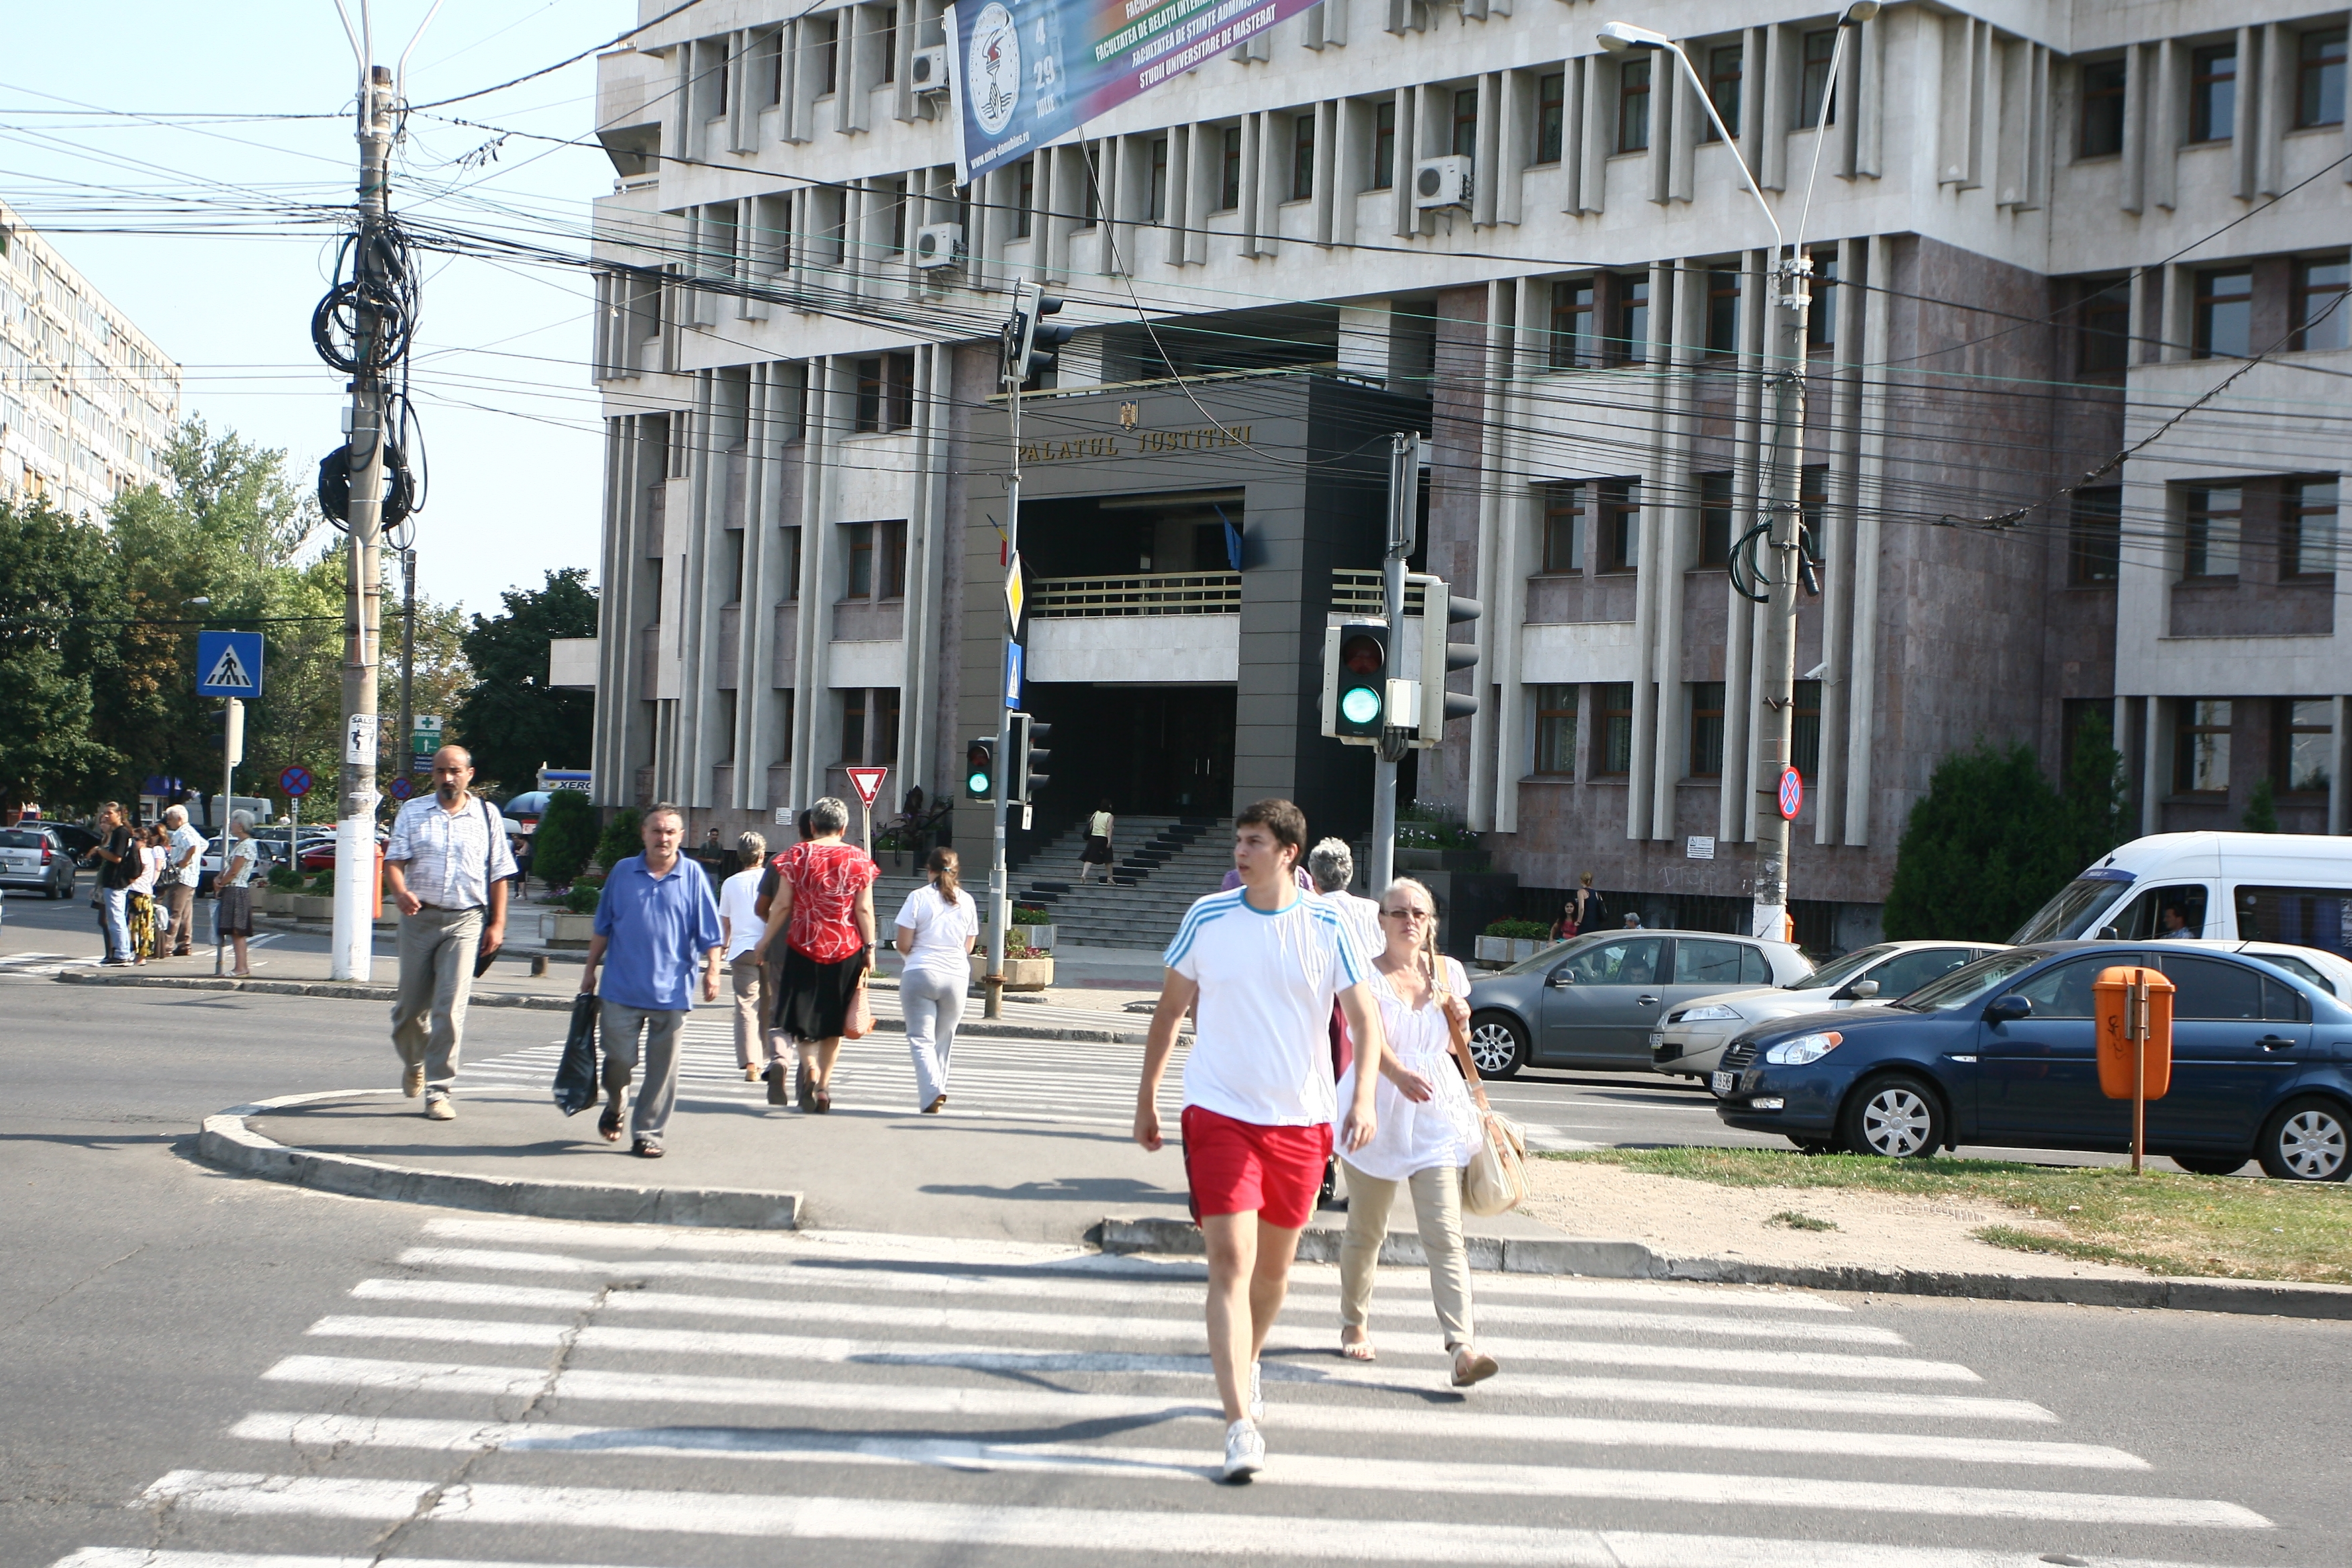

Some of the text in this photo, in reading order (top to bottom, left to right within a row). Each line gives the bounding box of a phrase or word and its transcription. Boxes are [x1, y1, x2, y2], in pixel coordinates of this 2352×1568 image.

[1125, 0, 1163, 19] FACUL
[1036, 17, 1046, 45] 4
[1095, 26, 1138, 62] FACULTATEA
[1138, 19, 1148, 39] DE
[1132, 32, 1175, 68] FACULTATEA
[1175, 26, 1186, 45] DE
[1139, 3, 1277, 89] STUDII UNIVERSITARE DE MASTERAT
[1034, 55, 1056, 91] 29
[970, 131, 1030, 170] www.univ-danubius.ro
[1019, 436, 1118, 462] PALATUL
